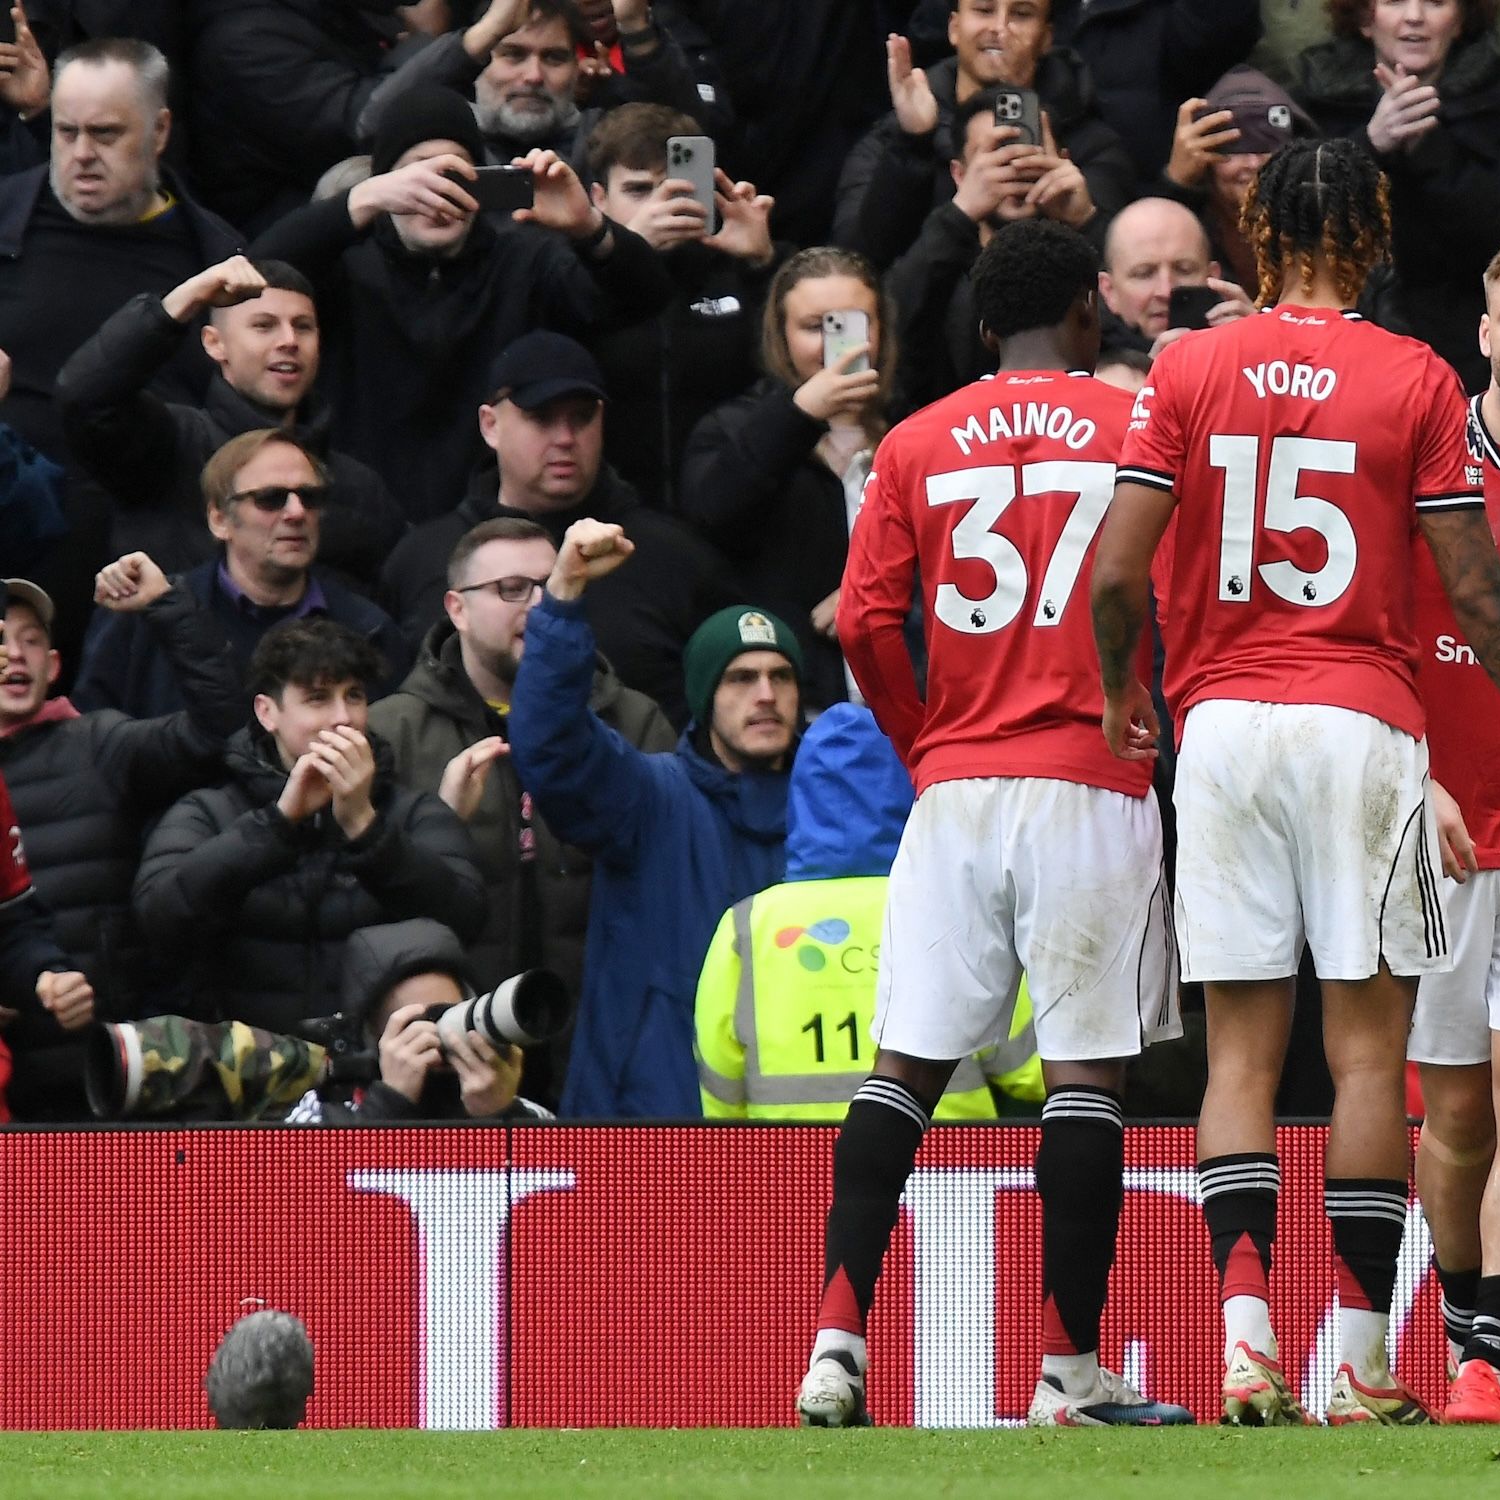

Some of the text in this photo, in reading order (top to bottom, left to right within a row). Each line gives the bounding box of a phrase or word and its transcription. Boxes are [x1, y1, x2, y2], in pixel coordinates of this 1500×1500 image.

[1242, 360, 1337, 401] YORO
[950, 402, 1096, 456] MAINOO
[925, 460, 1117, 634] 37
[1209, 434, 1357, 607] 15
[801, 1011, 875, 1063] 11
